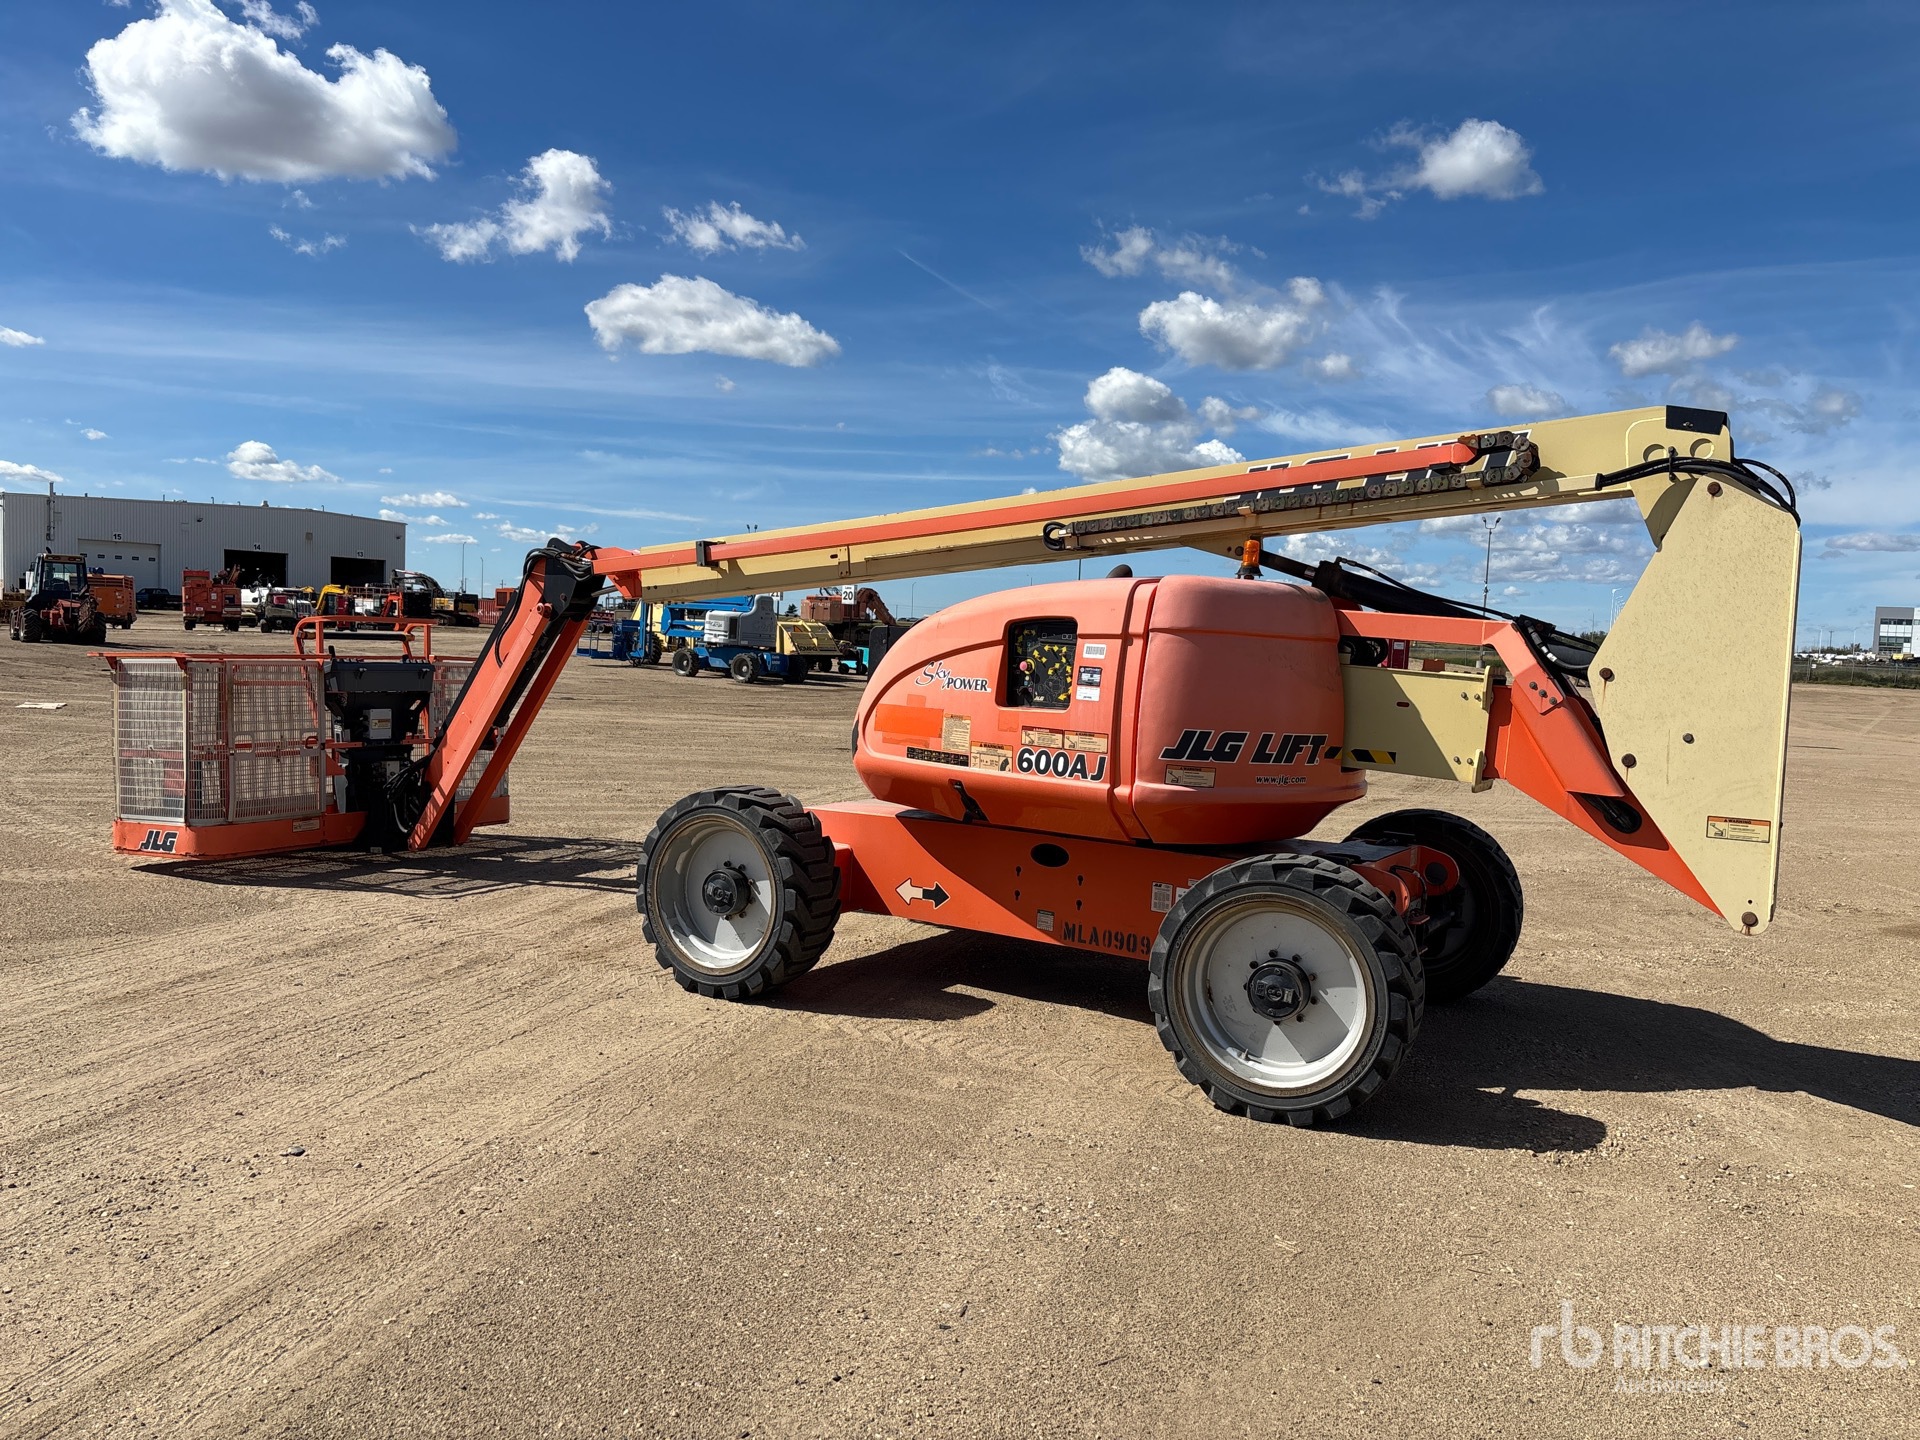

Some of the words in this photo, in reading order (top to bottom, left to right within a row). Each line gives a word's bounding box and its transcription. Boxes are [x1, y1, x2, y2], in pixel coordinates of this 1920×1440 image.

[843, 591, 853, 600] 20
[946, 677, 988, 692] POWER
[1158, 729, 1250, 763] JLG
[1250, 732, 1328, 765] LIFT
[1017, 747, 1107, 782] 600AJ
[1256, 775, 1307, 785] www.jlg.com
[140, 830, 179, 852] JLG
